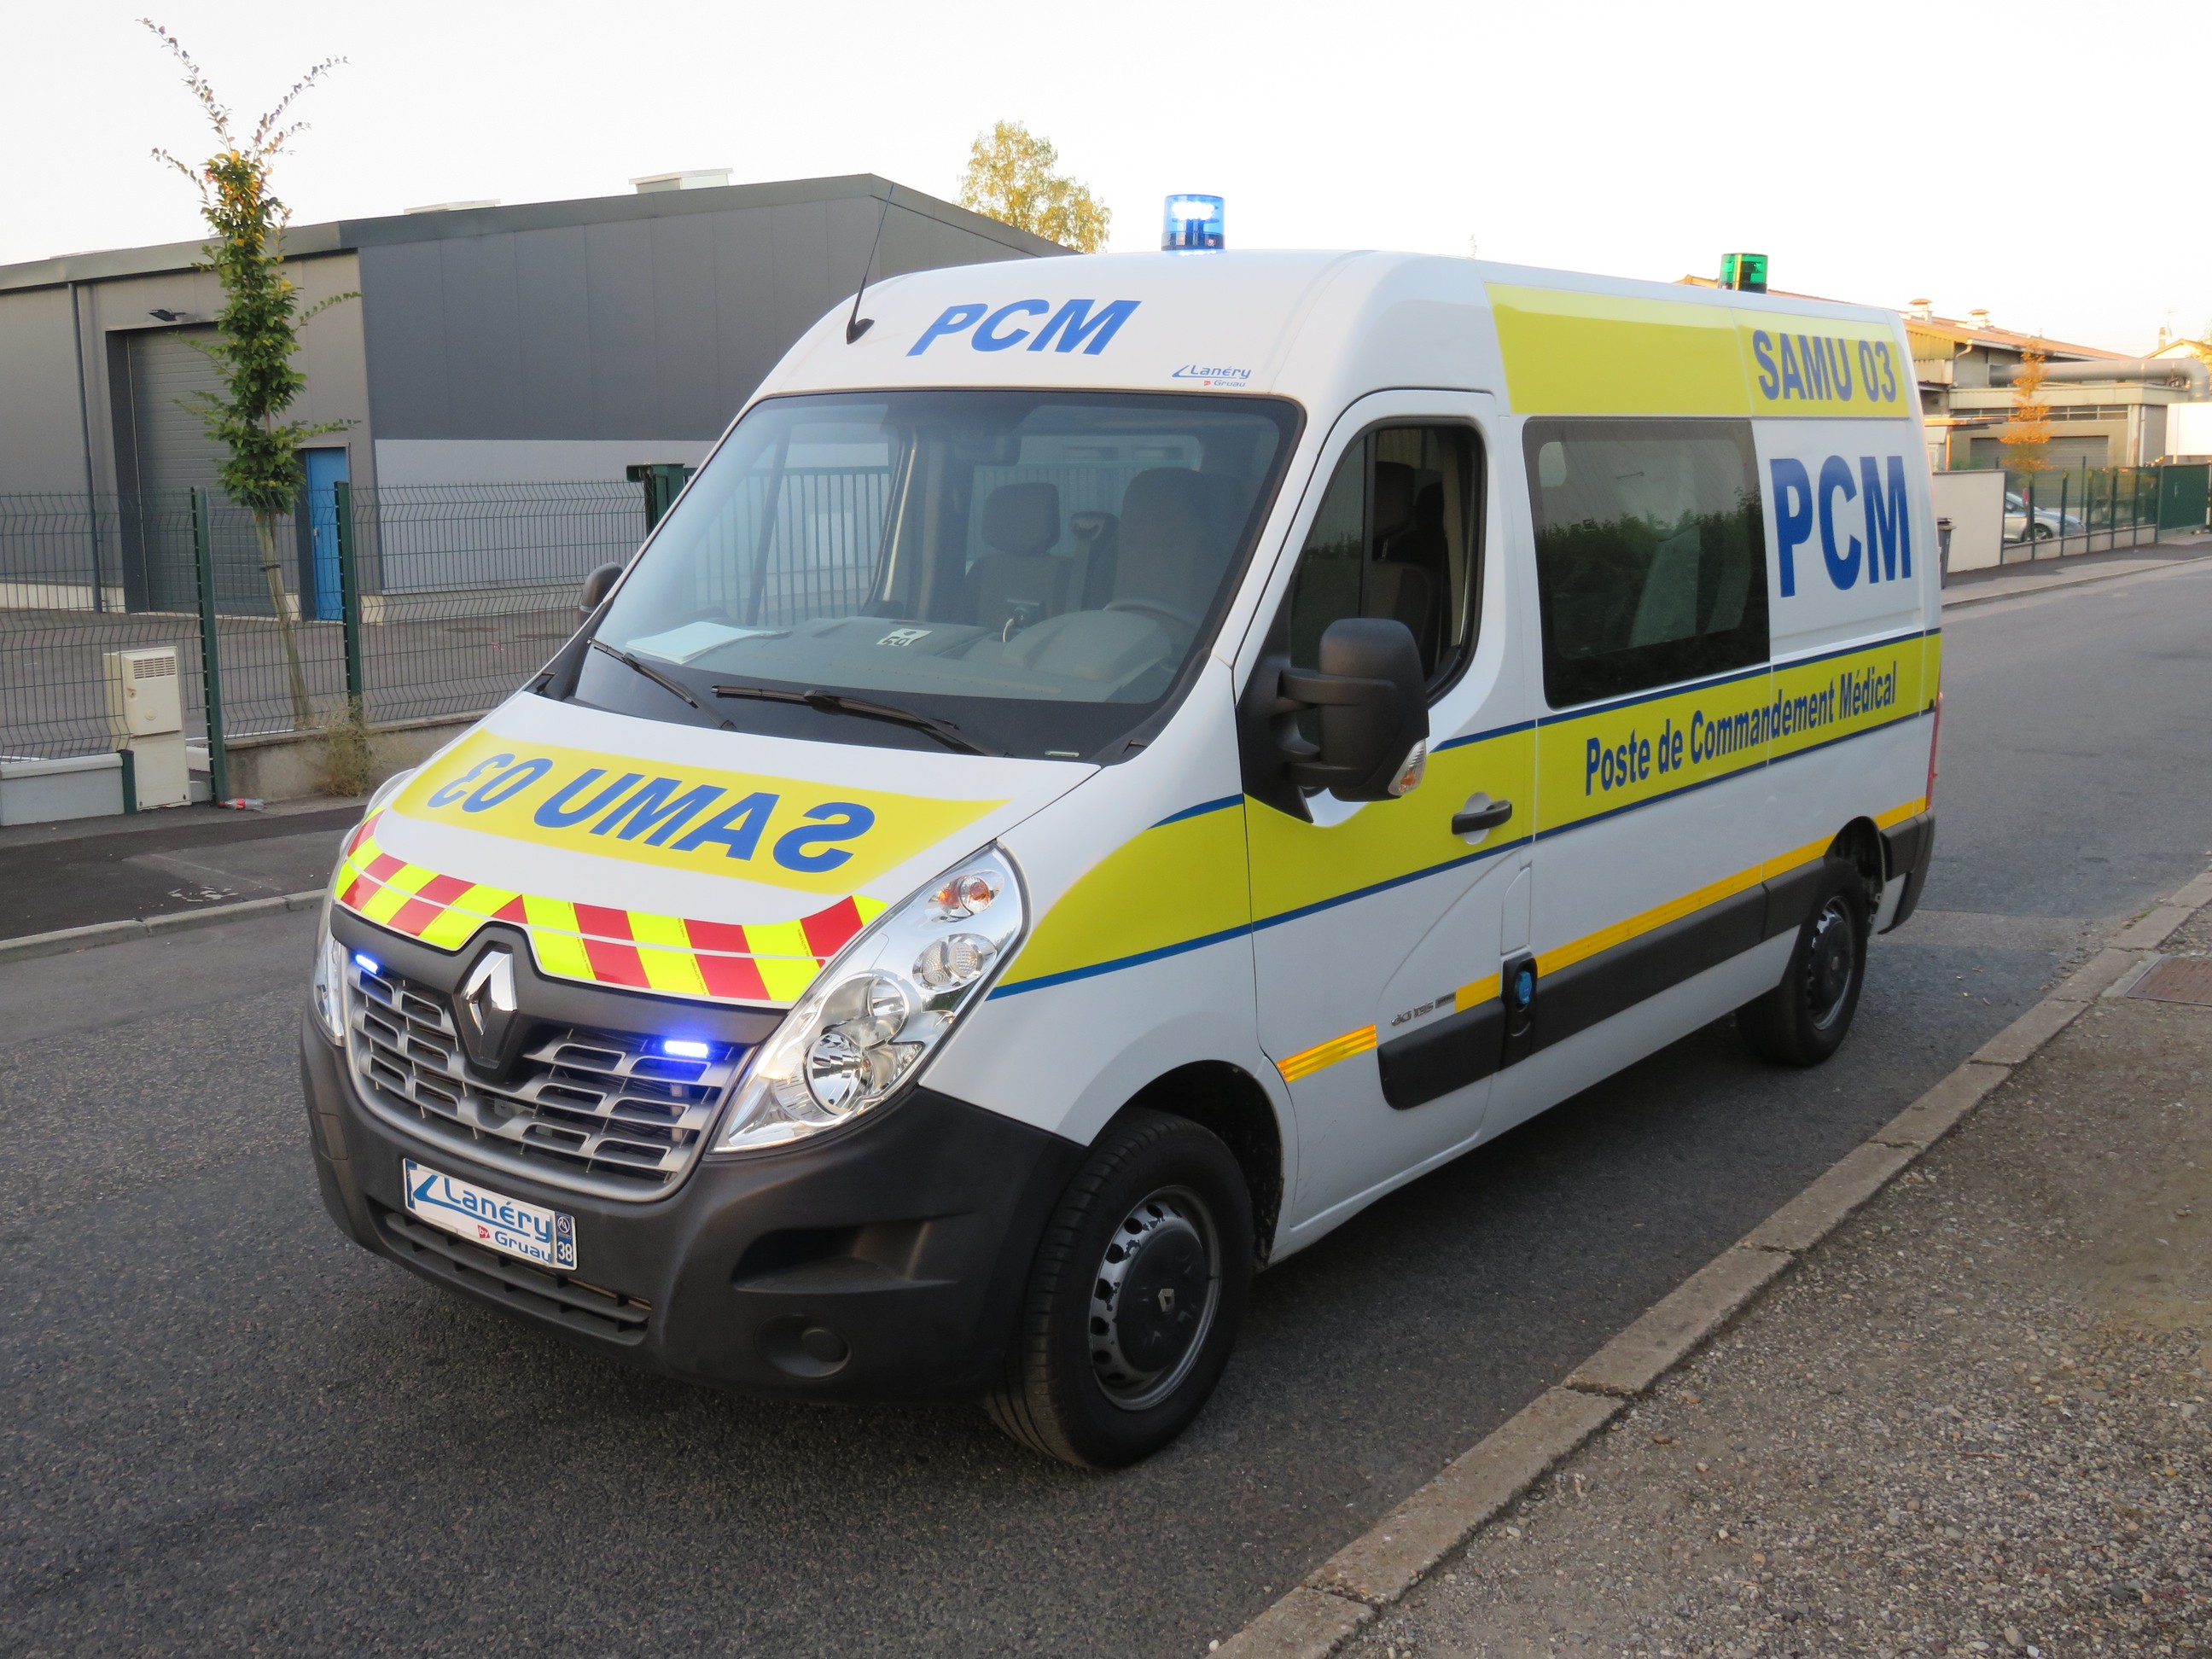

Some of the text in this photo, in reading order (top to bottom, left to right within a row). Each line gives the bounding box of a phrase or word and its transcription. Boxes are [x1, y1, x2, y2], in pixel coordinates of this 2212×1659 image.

[906, 299, 1142, 357] PCM
[1190, 364, 1252, 380] Lanéry
[1753, 329, 1896, 403] SAMU 03
[1769, 456, 1912, 598] PCM
[1585, 661, 1897, 796] Poste de Commandement Médical
[444, 1176, 551, 1244] Lanéry
[479, 1226, 551, 1264] by Gruau
[557, 1241, 573, 1262] 38
